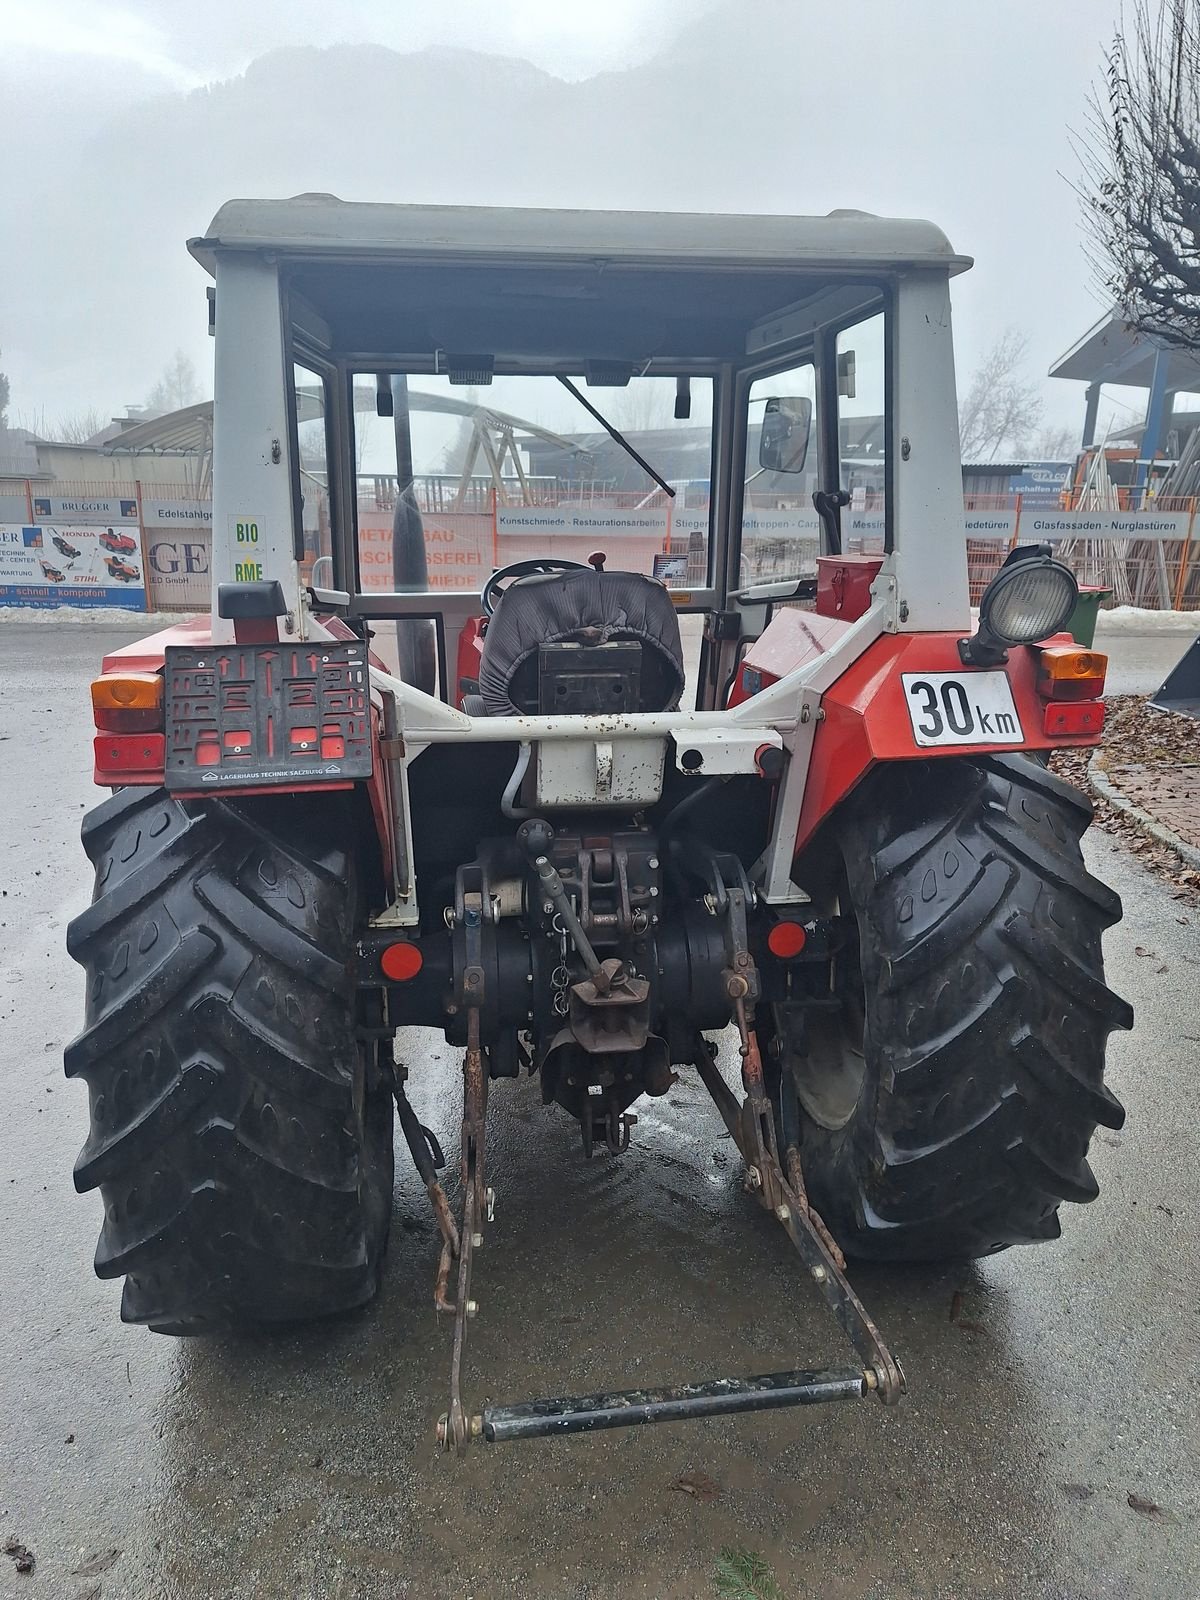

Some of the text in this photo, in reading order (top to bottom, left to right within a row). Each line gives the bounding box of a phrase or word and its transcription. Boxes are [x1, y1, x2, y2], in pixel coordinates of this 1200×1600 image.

[500, 516, 565, 526] Kunstschmiede
[573, 518, 666, 528] Restaurationsarbeiten
[1033, 520, 1102, 530] Glasfassaden
[1111, 521, 1176, 532] Nurglastüren
[236, 523, 258, 542] BIO
[149, 542, 212, 574] GE
[235, 563, 263, 581] RME
[73, 575, 100, 583] STIHL
[165, 576, 189, 584] GmbH
[16, 587, 49, 596] schnell
[58, 588, 107, 598] kompetent
[911, 681, 1016, 737] 30 km
[220, 772, 260, 780] LAGERHAUS
[289, 768, 323, 777] SALZBURG
